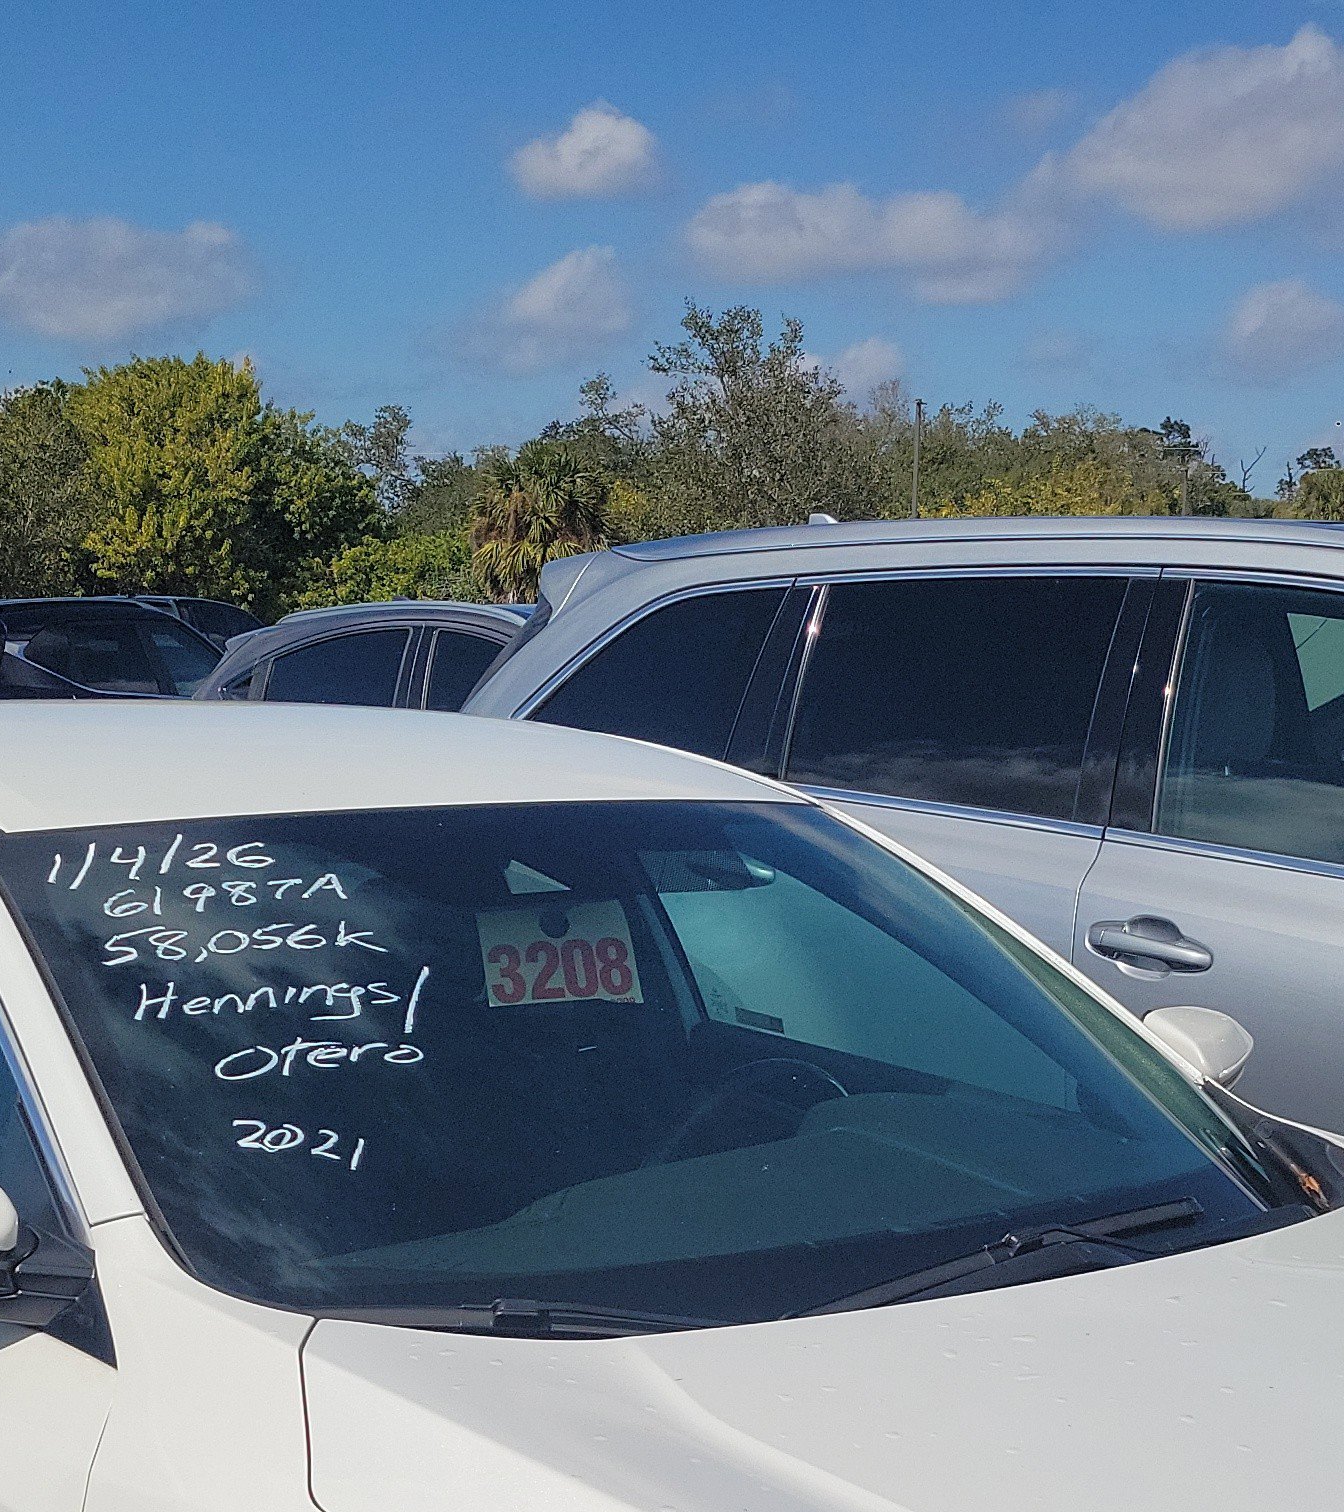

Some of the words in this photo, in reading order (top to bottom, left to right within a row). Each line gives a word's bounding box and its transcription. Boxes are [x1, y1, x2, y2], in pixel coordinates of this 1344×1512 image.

[47, 833, 276, 890] 1/4/26
[487, 936, 634, 1004] 3208
[214, 1036, 425, 1081] Otero
[232, 1118, 365, 1171] 2021
